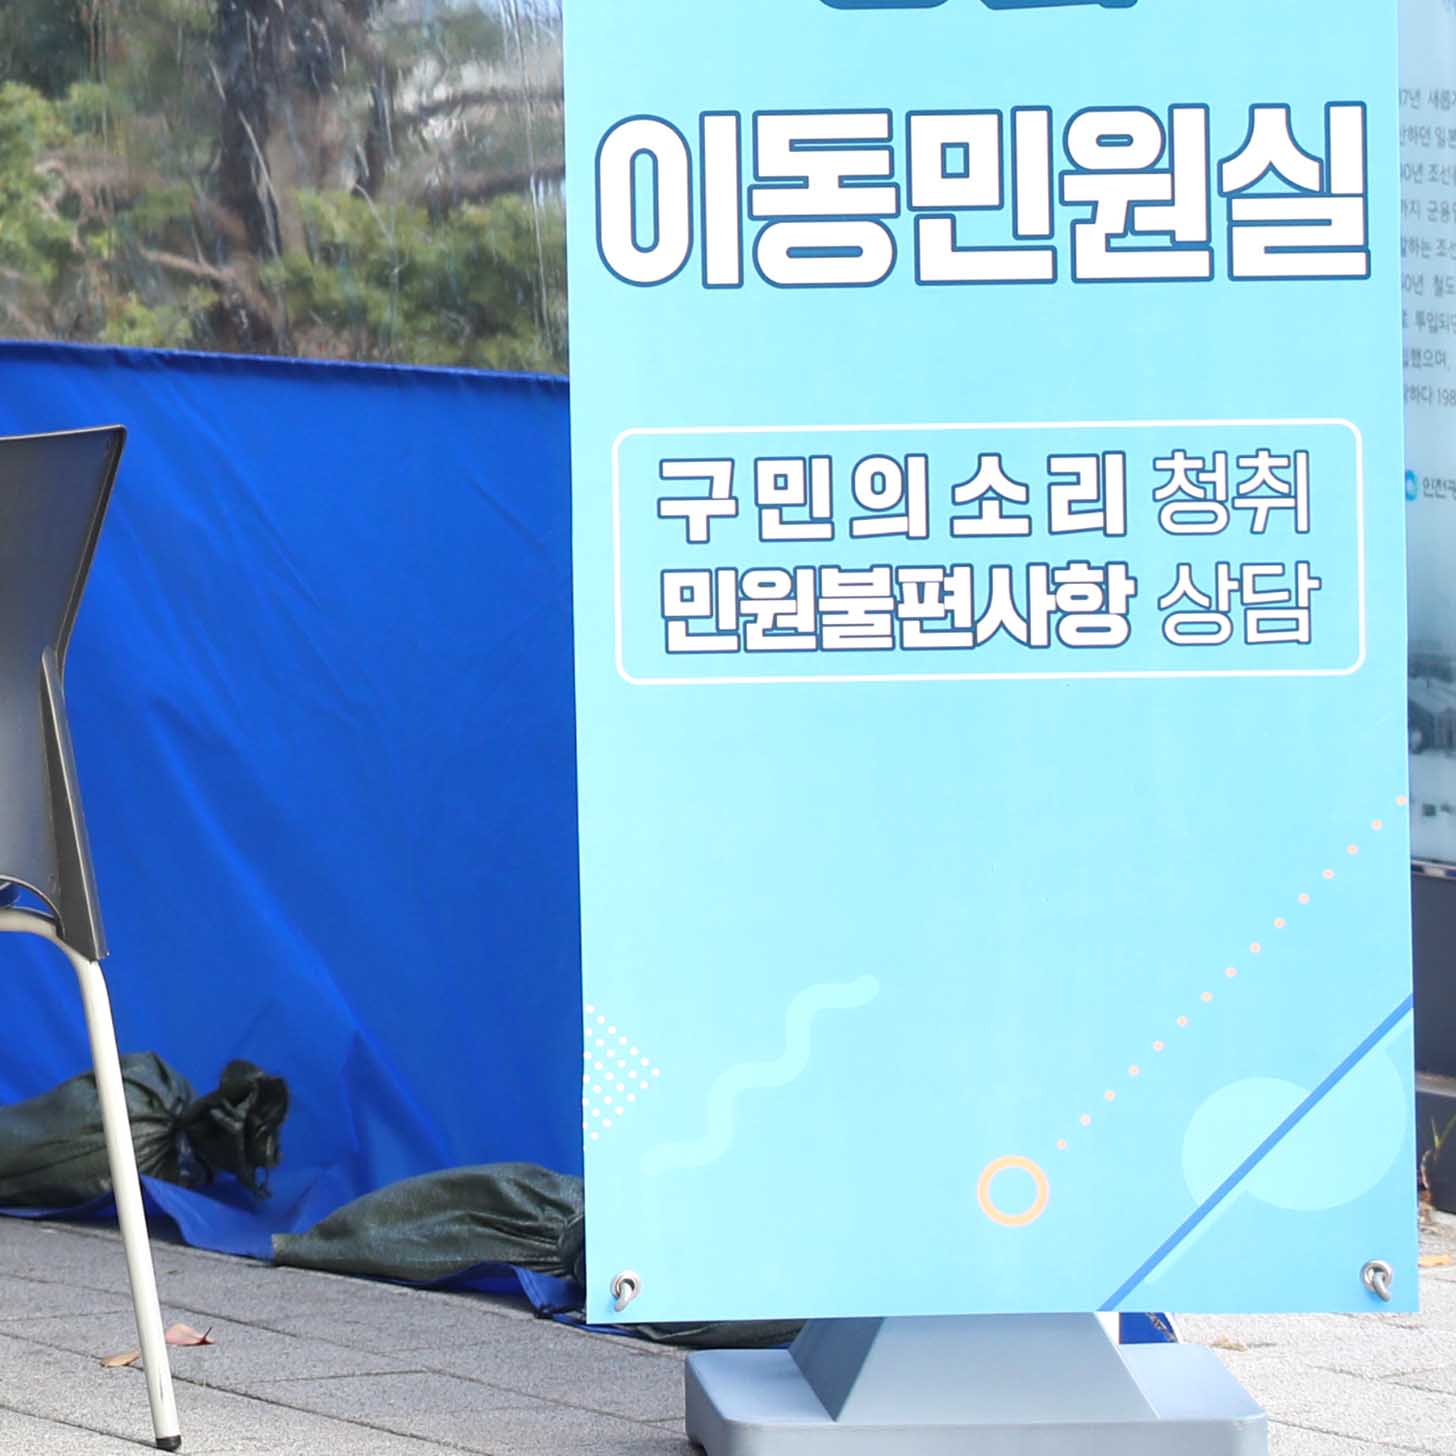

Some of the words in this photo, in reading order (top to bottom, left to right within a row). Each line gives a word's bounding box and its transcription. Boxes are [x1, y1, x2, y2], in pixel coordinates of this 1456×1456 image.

[594, 101, 1371, 288] 이동민원실
[1152, 448, 1312, 535] 청취
[660, 561, 1138, 653] 민원불편사항
[1157, 561, 1322, 646] 상담
